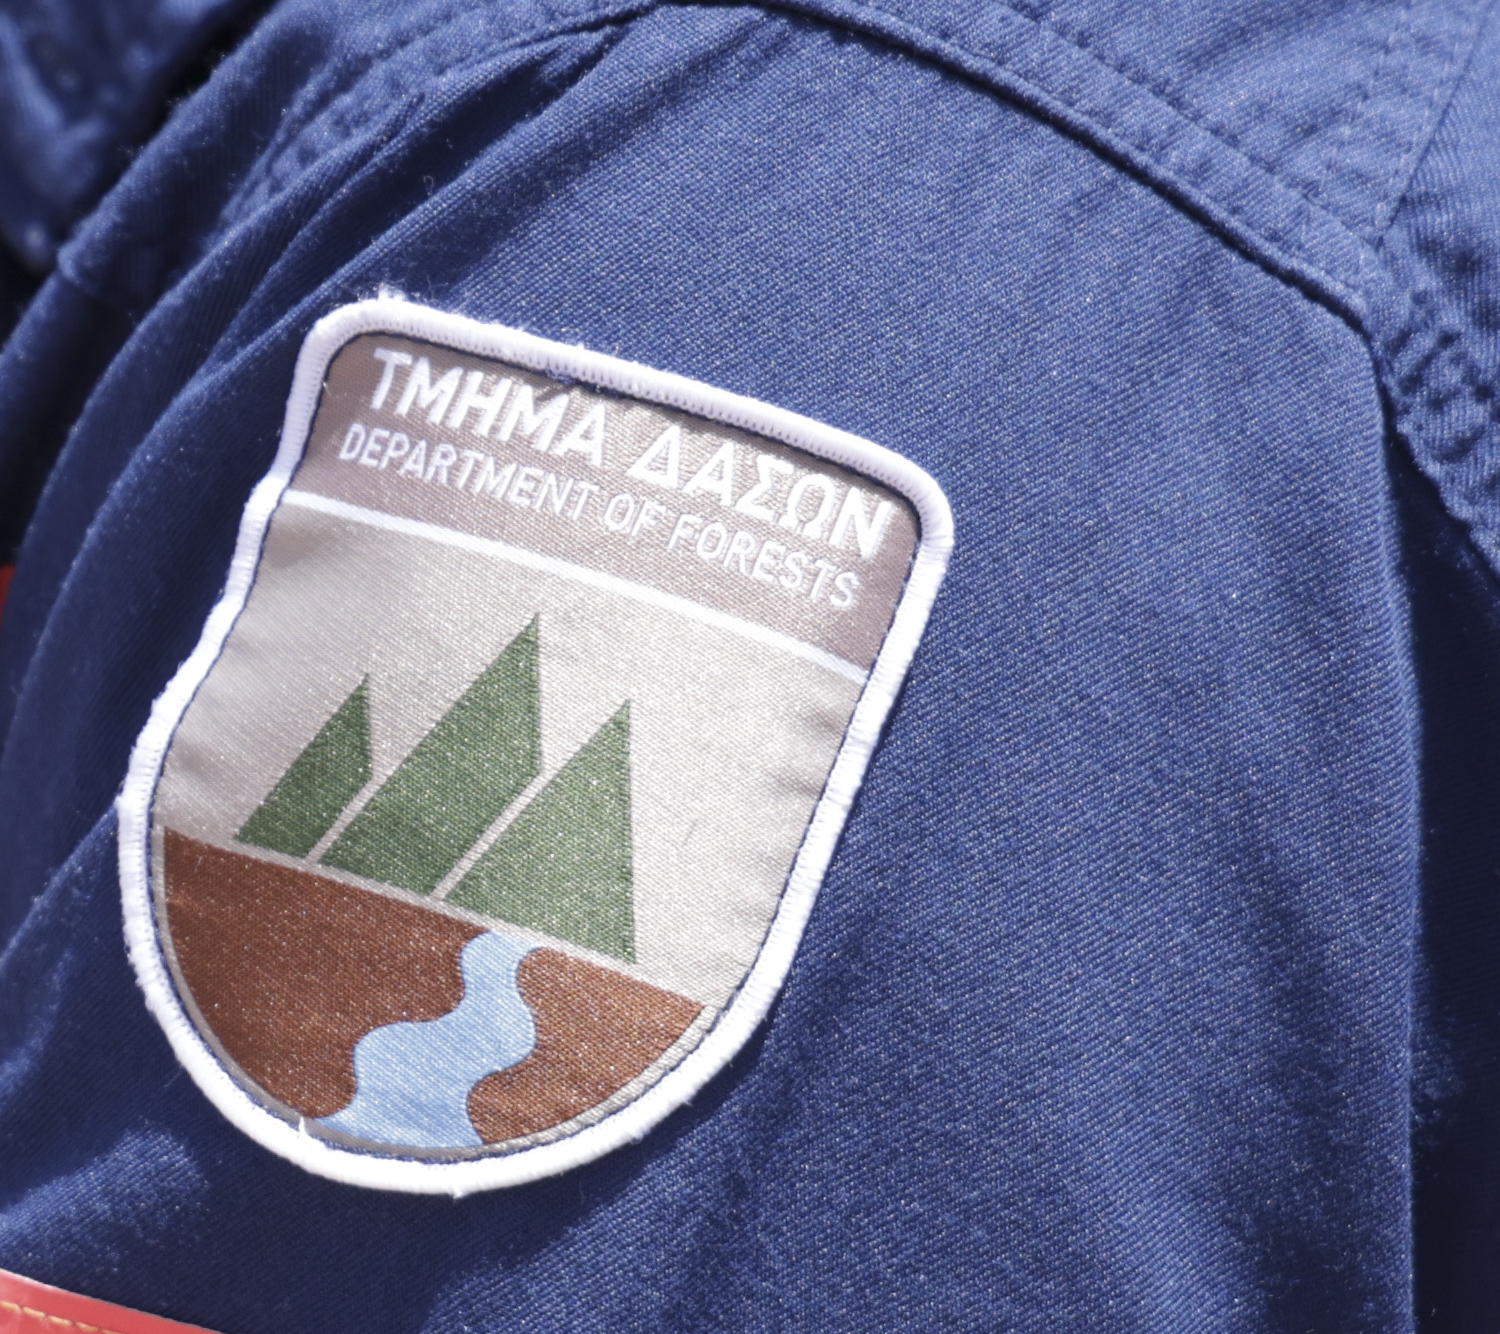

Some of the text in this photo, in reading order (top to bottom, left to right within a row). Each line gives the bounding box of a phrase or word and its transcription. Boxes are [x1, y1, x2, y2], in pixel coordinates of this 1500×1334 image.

[338, 422, 862, 608] DEPARTMENT OF FORESTS
[369, 347, 895, 559] ΤΜΗΜΑ ΔΑΣΩΝ
